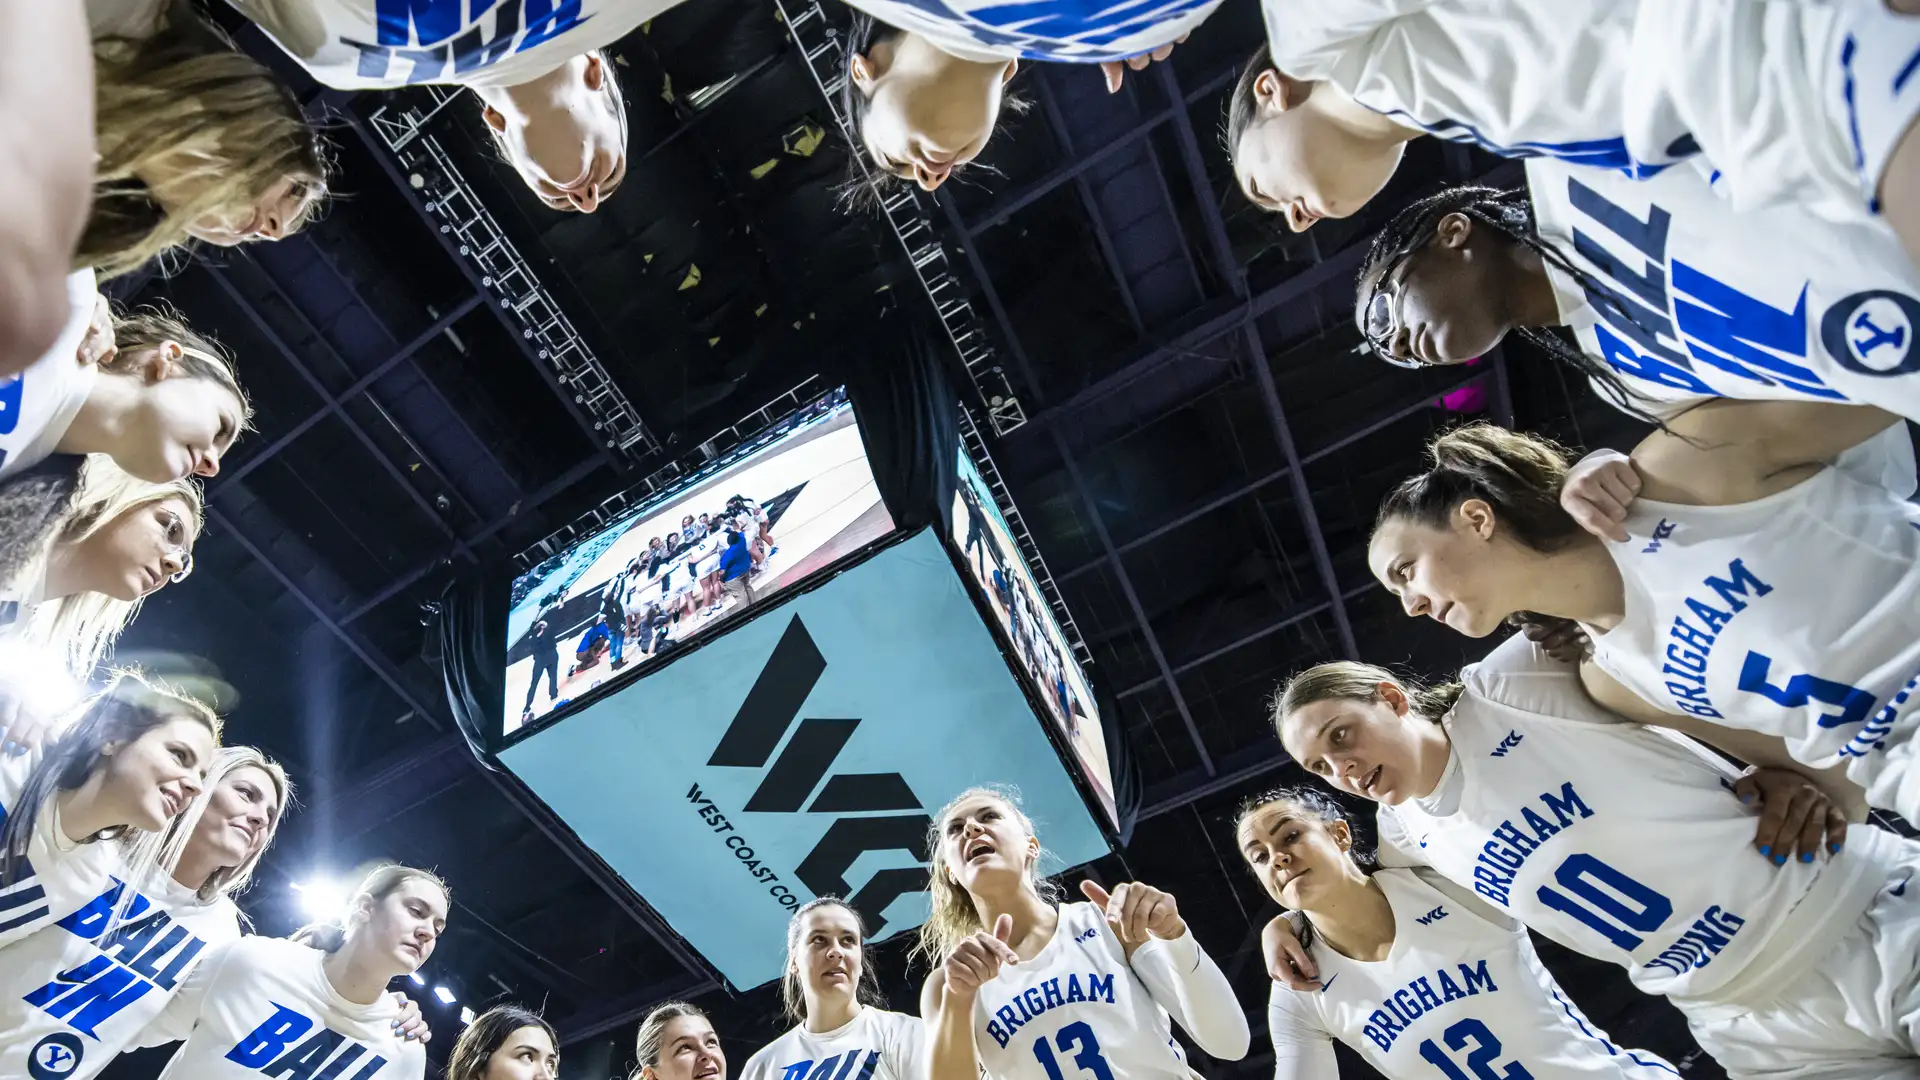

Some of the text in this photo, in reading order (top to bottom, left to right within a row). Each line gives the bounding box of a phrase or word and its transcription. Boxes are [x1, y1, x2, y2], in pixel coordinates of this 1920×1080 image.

[1568, 175, 1732, 398] BALL
[1671, 258, 1850, 400] IN
[1663, 557, 1774, 719] BRIGHAM
[1737, 650, 1877, 728] 5
[686, 782, 734, 834] WEST
[725, 835, 779, 884] COAST
[1474, 781, 1595, 907] BRIGHAM
[54, 874, 207, 992] BALL
[1536, 853, 1674, 952] 10
[1643, 905, 1746, 976] YOUNG
[986, 973, 1115, 1049] BRIGHAM
[1033, 1021, 1115, 1080] 13
[1363, 960, 1498, 1053] BRIGHAM
[1419, 1018, 1535, 1080] 12
